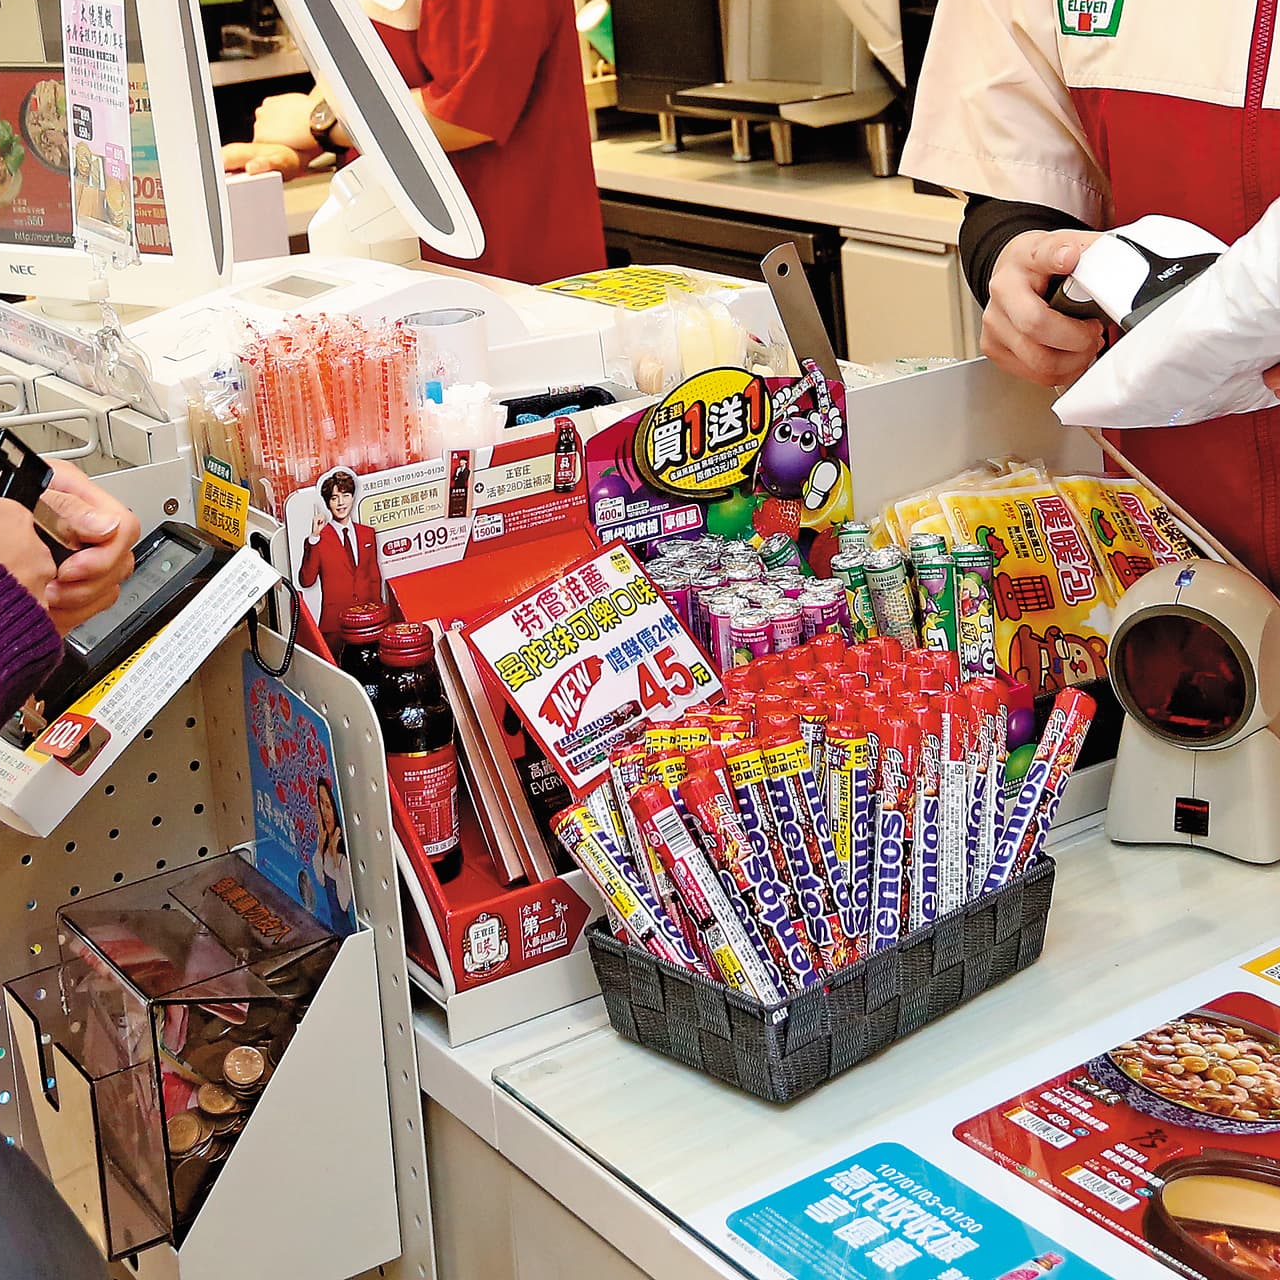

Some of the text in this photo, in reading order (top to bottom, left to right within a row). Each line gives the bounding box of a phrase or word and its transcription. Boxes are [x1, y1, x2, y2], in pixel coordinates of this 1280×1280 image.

[9, 263, 37, 276] NEC
[652, 377, 763, 471] 買1送1
[654, 402, 684, 426] 任選
[505, 464, 531, 480] 正官庄
[204, 482, 242, 513] 國泰世華卡
[369, 504, 425, 526] EVERYTIME
[412, 526, 448, 551] 199
[1033, 495, 1097, 606] 暖暖包
[511, 563, 611, 637] 特價推薦
[495, 575, 659, 692] 曼陀珠可樂口味
[549, 660, 595, 722] NEW
[636, 645, 713, 712] 45 元
[43, 719, 83, 749] 100
[560, 712, 613, 747] mentos
[573, 729, 625, 766] mentos
[584, 841, 604, 869] SHARE
[601, 865, 620, 891] TIME
[522, 901, 542, 915] 全球
[473, 925, 496, 940] 正官庄
[523, 914, 554, 937] 第一
[1046, 1111, 1071, 1128] 499
[874, 1161, 984, 1236] 107/01/03~01/30
[804, 1196, 924, 1271] 享優惠
